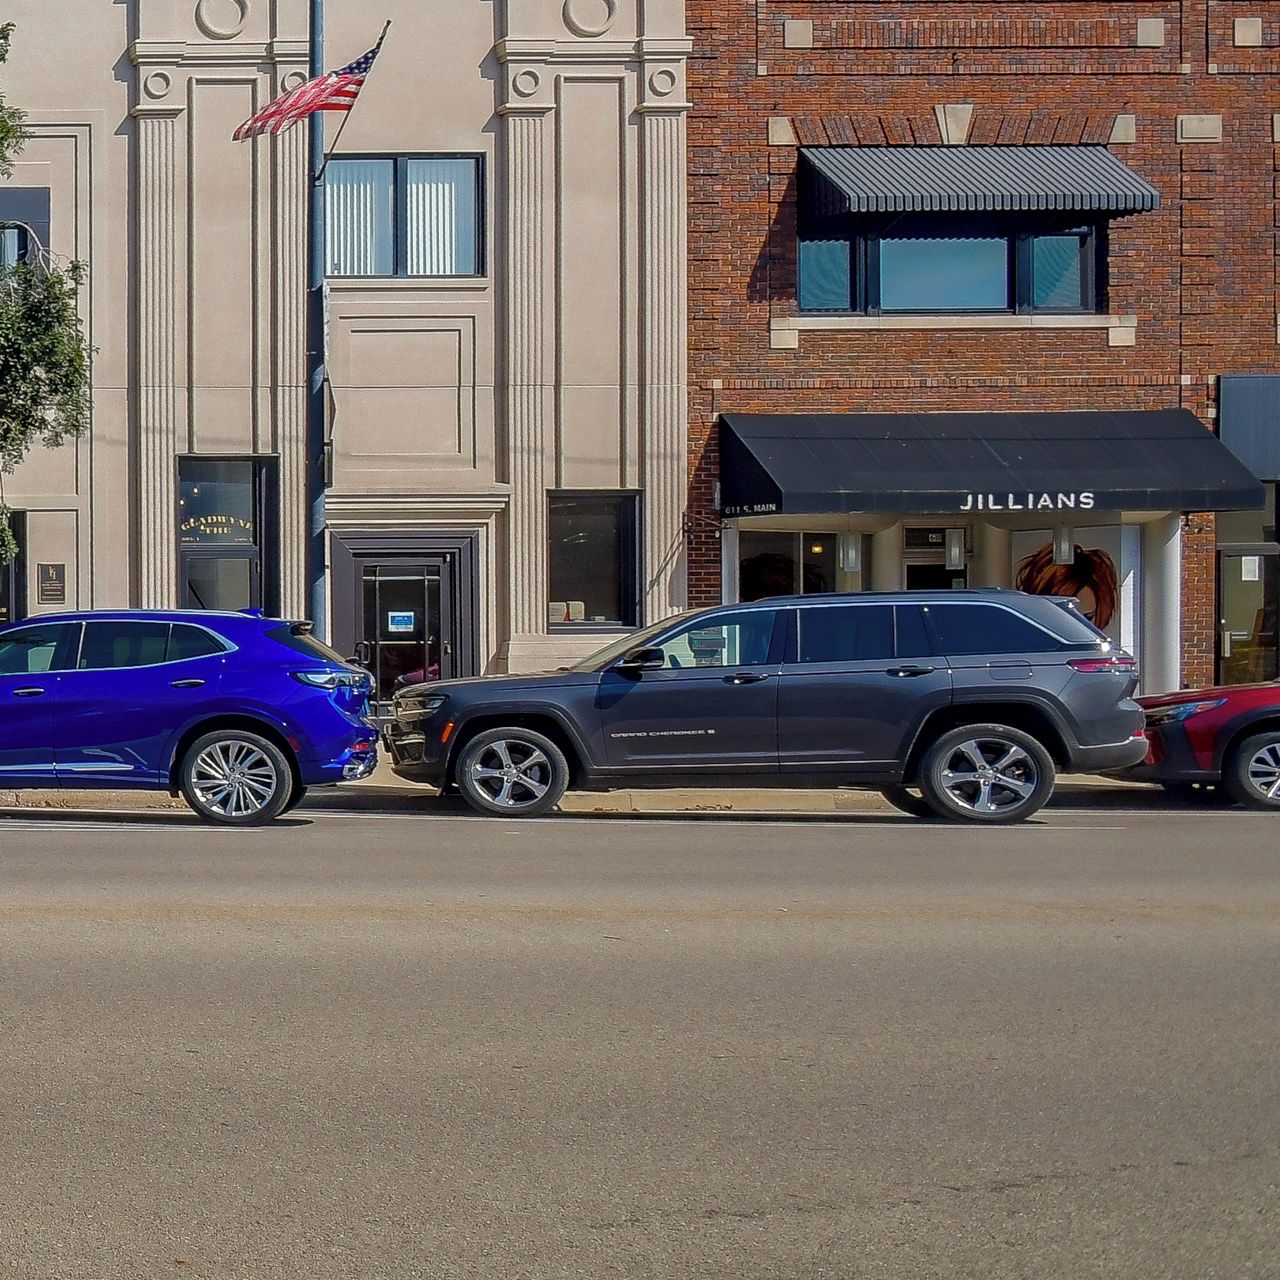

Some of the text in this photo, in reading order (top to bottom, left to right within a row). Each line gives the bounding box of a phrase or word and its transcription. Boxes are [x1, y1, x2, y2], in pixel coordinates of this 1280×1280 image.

[959, 492, 1095, 510] JILLIANS
[753, 503, 777, 513] MAIN
[649, 729, 705, 737] CHEROKEE
